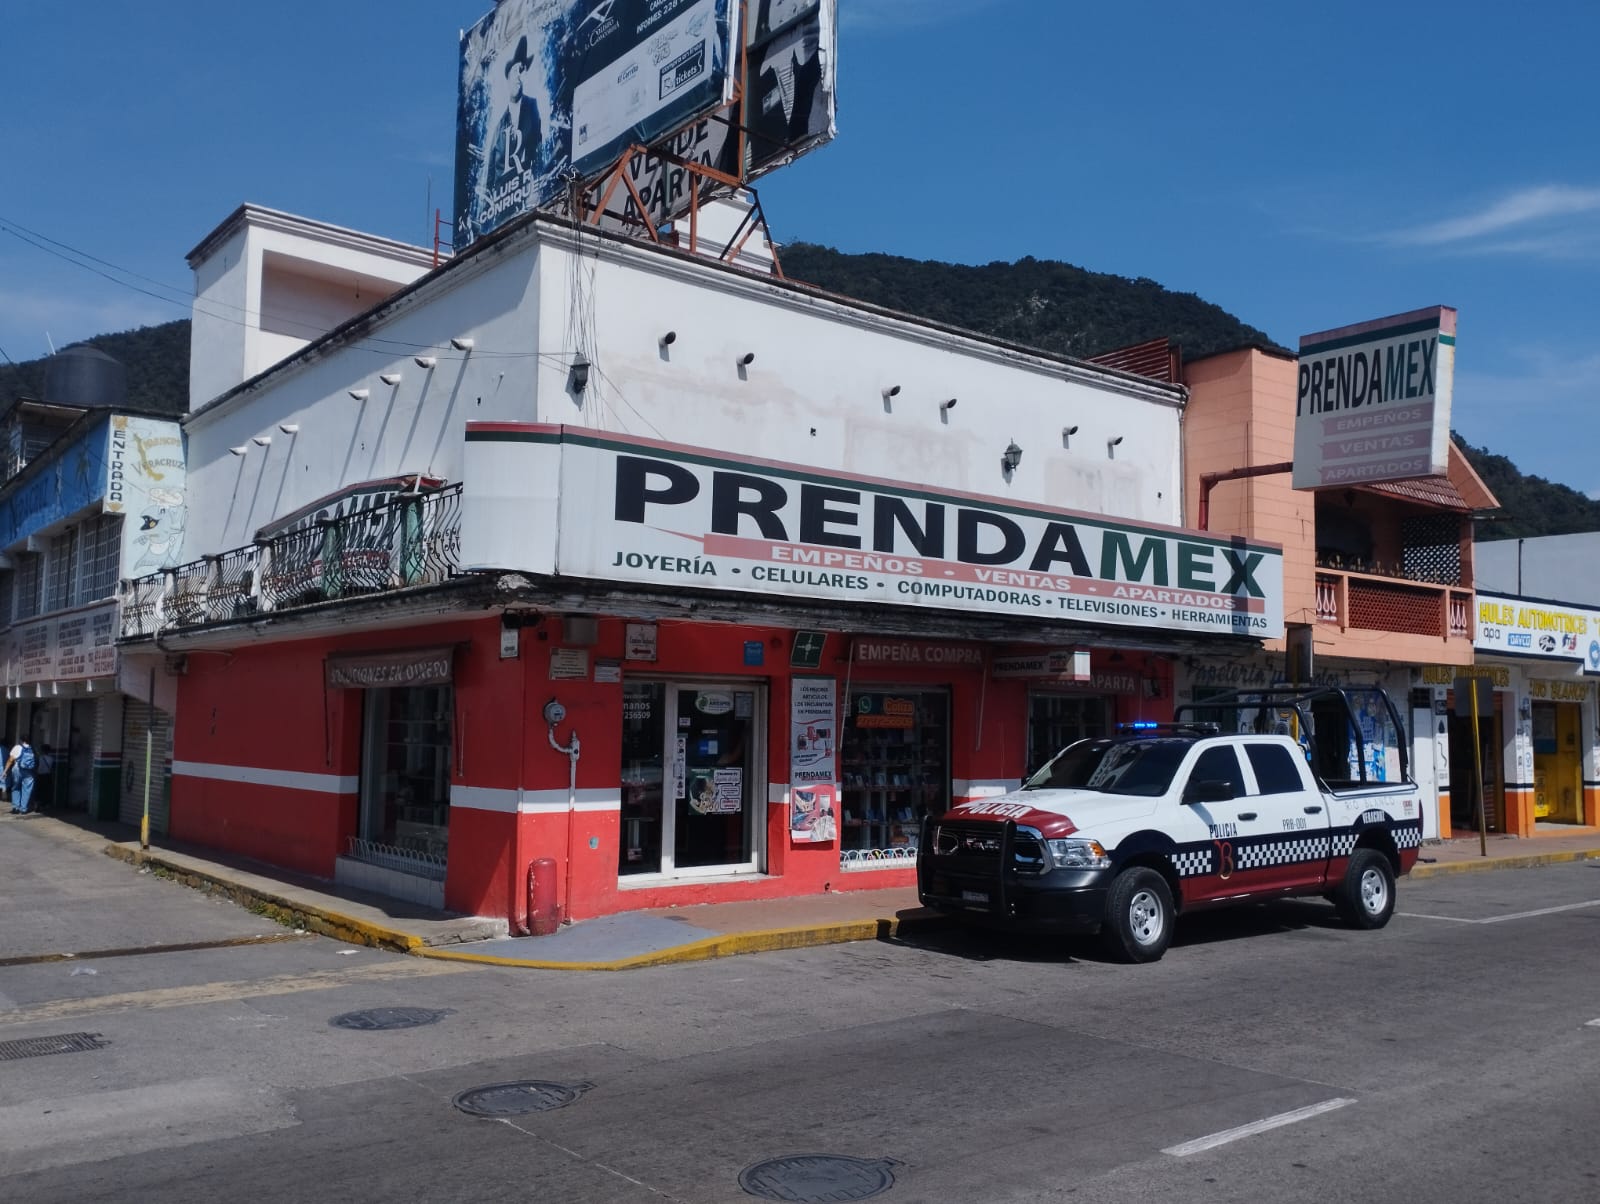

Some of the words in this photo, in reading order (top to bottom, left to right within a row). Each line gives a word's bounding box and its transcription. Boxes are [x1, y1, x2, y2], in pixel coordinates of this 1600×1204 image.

[493, 177, 520, 204] LUIS
[1297, 337, 1437, 416] PRENDAMEX
[1336, 408, 1422, 430] EMPEÑOS
[1340, 434, 1415, 454] VENTAS
[109, 430, 126, 502] ENTRADA
[1326, 459, 1425, 481] APARTADOS
[614, 455, 1266, 598] PRENDAMEX
[612, 551, 717, 576] JOYERÍA
[751, 566, 869, 590] CELULARES
[897, 580, 1041, 607] COMPUTADORAS
[1057, 597, 1158, 618] TELEVISIONES
[1171, 608, 1267, 629] HERRAMIENTAS
[771, 545, 923, 575] EMPEÑOS
[974, 568, 1071, 591] VENTAS
[1113, 586, 1236, 609] APARTADOS
[1479, 602, 1515, 626] HULES
[1517, 607, 1588, 635] AUTOMOTRICES
[858, 643, 920, 662] EMPEÑA
[924, 646, 981, 664] COMPRA
[623, 711, 651, 720] 256509
[1209, 822, 1238, 838] POLICIA
